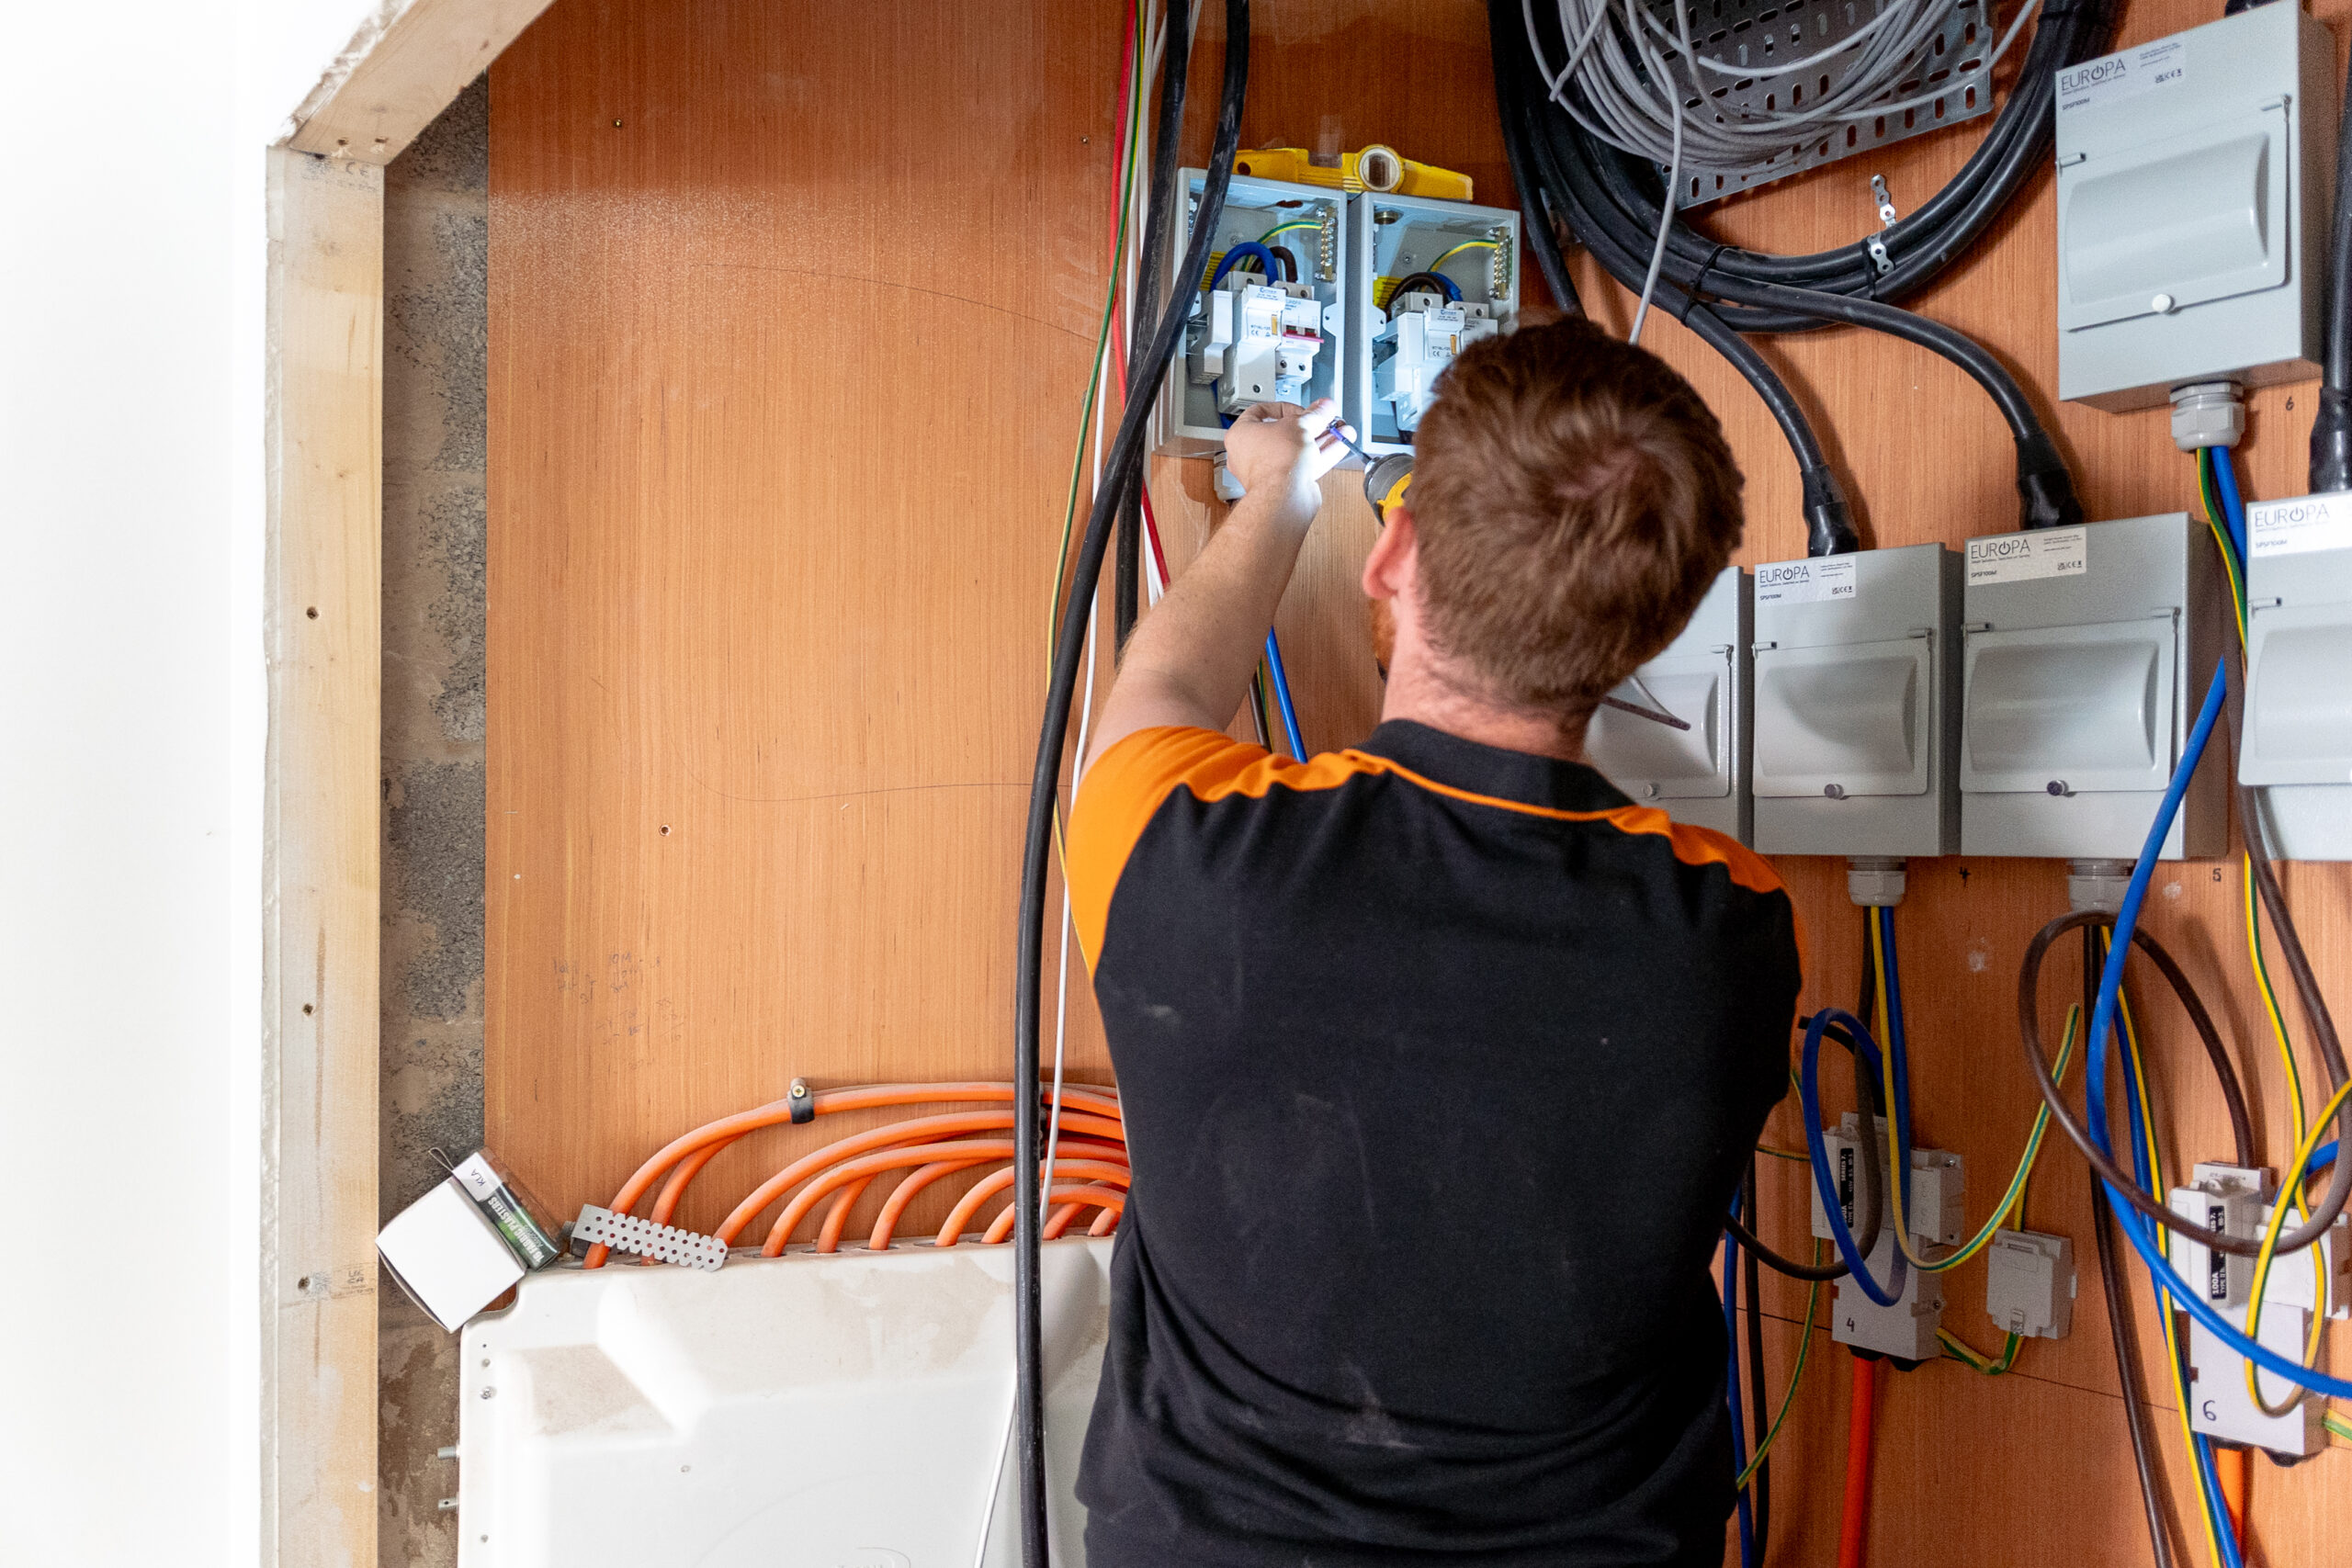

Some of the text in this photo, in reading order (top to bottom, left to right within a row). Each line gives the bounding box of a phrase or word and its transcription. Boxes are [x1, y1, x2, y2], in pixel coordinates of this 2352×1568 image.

[2061, 58, 2126, 91] EUROPA
[2286, 396, 2294, 412] 6
[2255, 503, 2330, 527] EUROPA
[1971, 538, 2030, 559] EUROPA
[1758, 565, 1810, 583] EUROPA
[1959, 866, 1971, 887] 4
[2212, 867, 2222, 882] 5
[487, 1196, 517, 1231] PLASTERS
[513, 1227, 538, 1255] FABRIC
[1847, 1317, 1855, 1332] 4
[2203, 1399, 2217, 1421] 6
